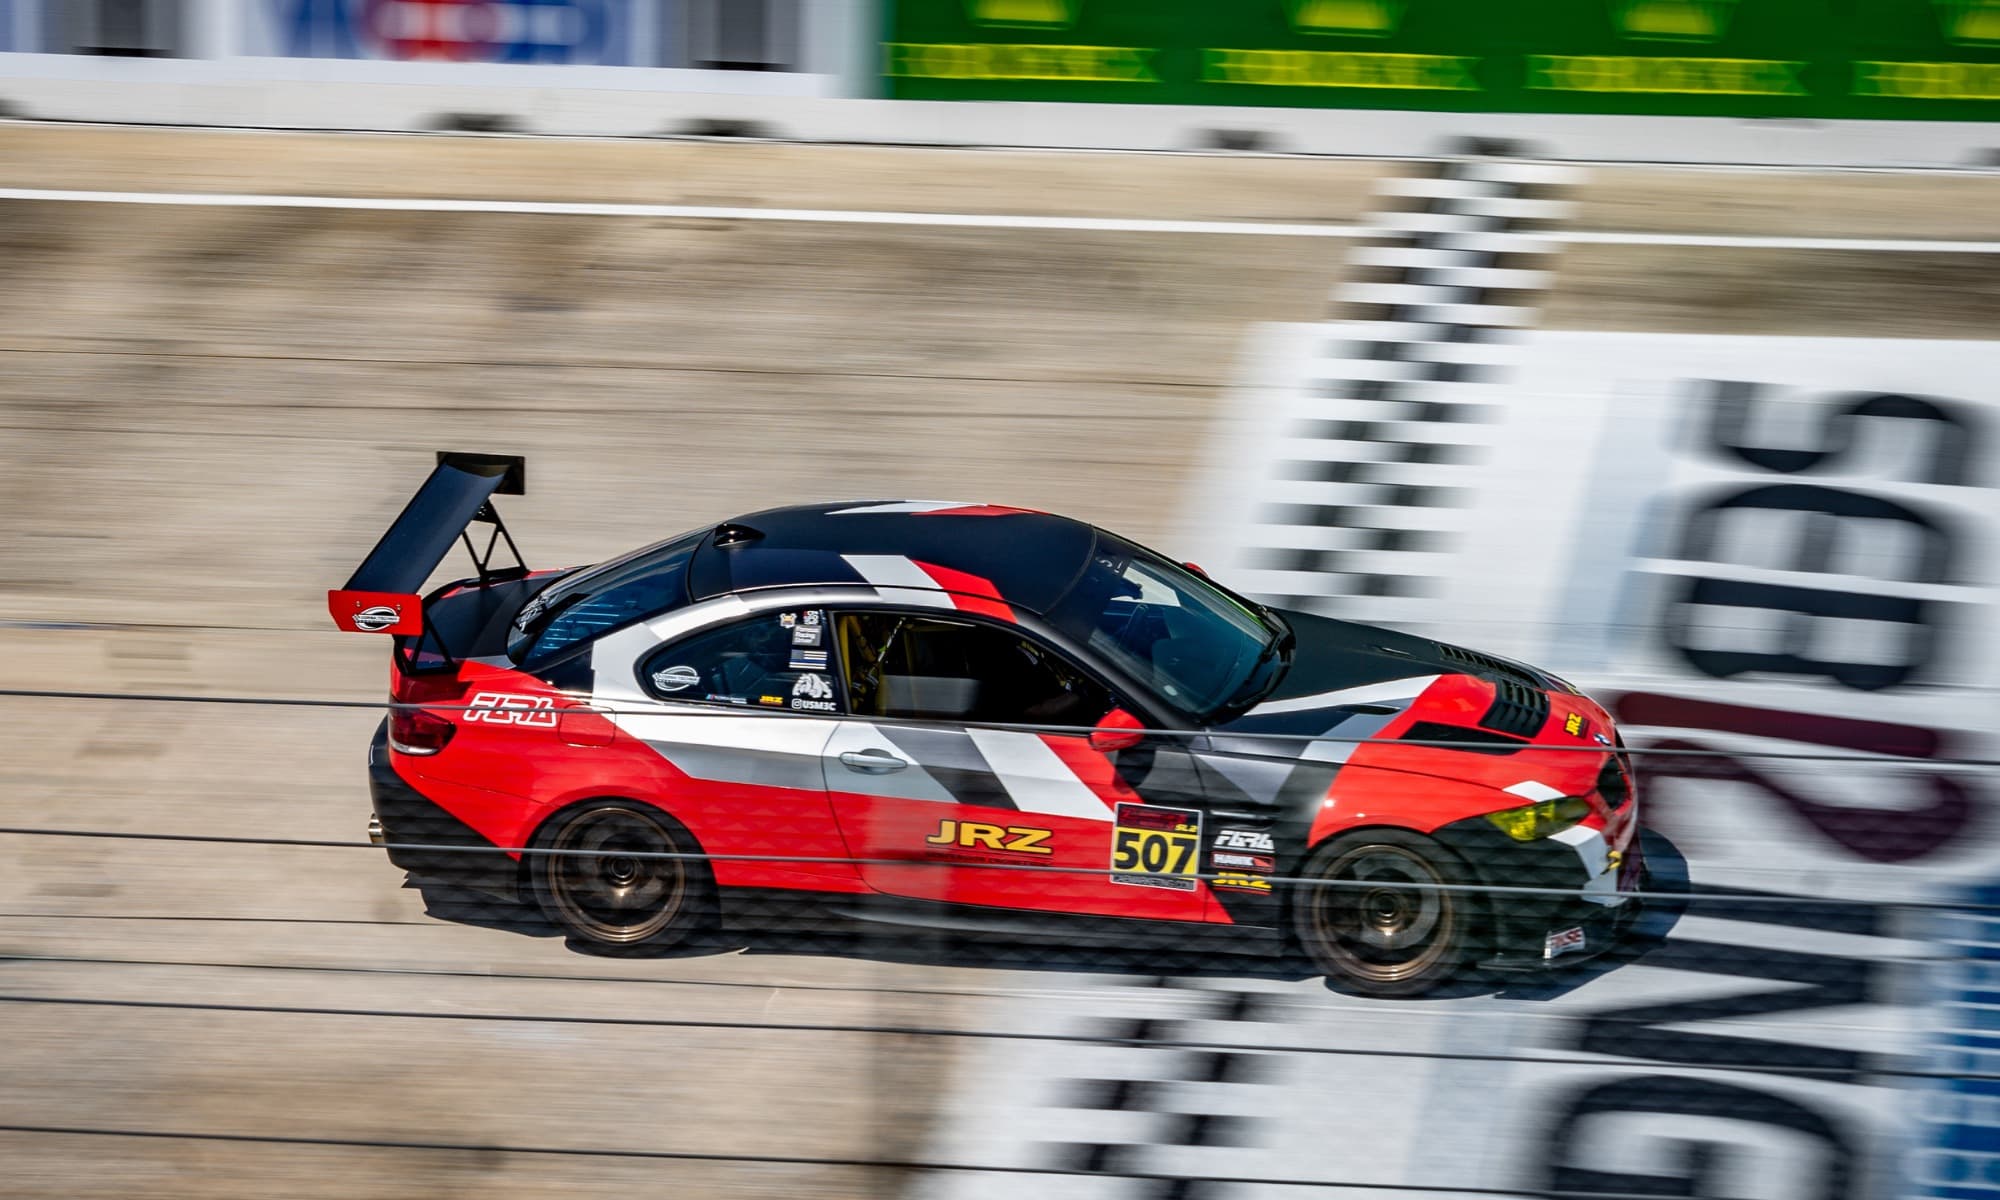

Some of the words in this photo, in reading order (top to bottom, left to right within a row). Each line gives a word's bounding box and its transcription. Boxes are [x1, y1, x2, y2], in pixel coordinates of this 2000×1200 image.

[1565, 712, 1583, 736] JRZ
[926, 819, 1053, 854] JRZ
[1113, 830, 1197, 874] 507
[1212, 871, 1273, 889] JRZ
